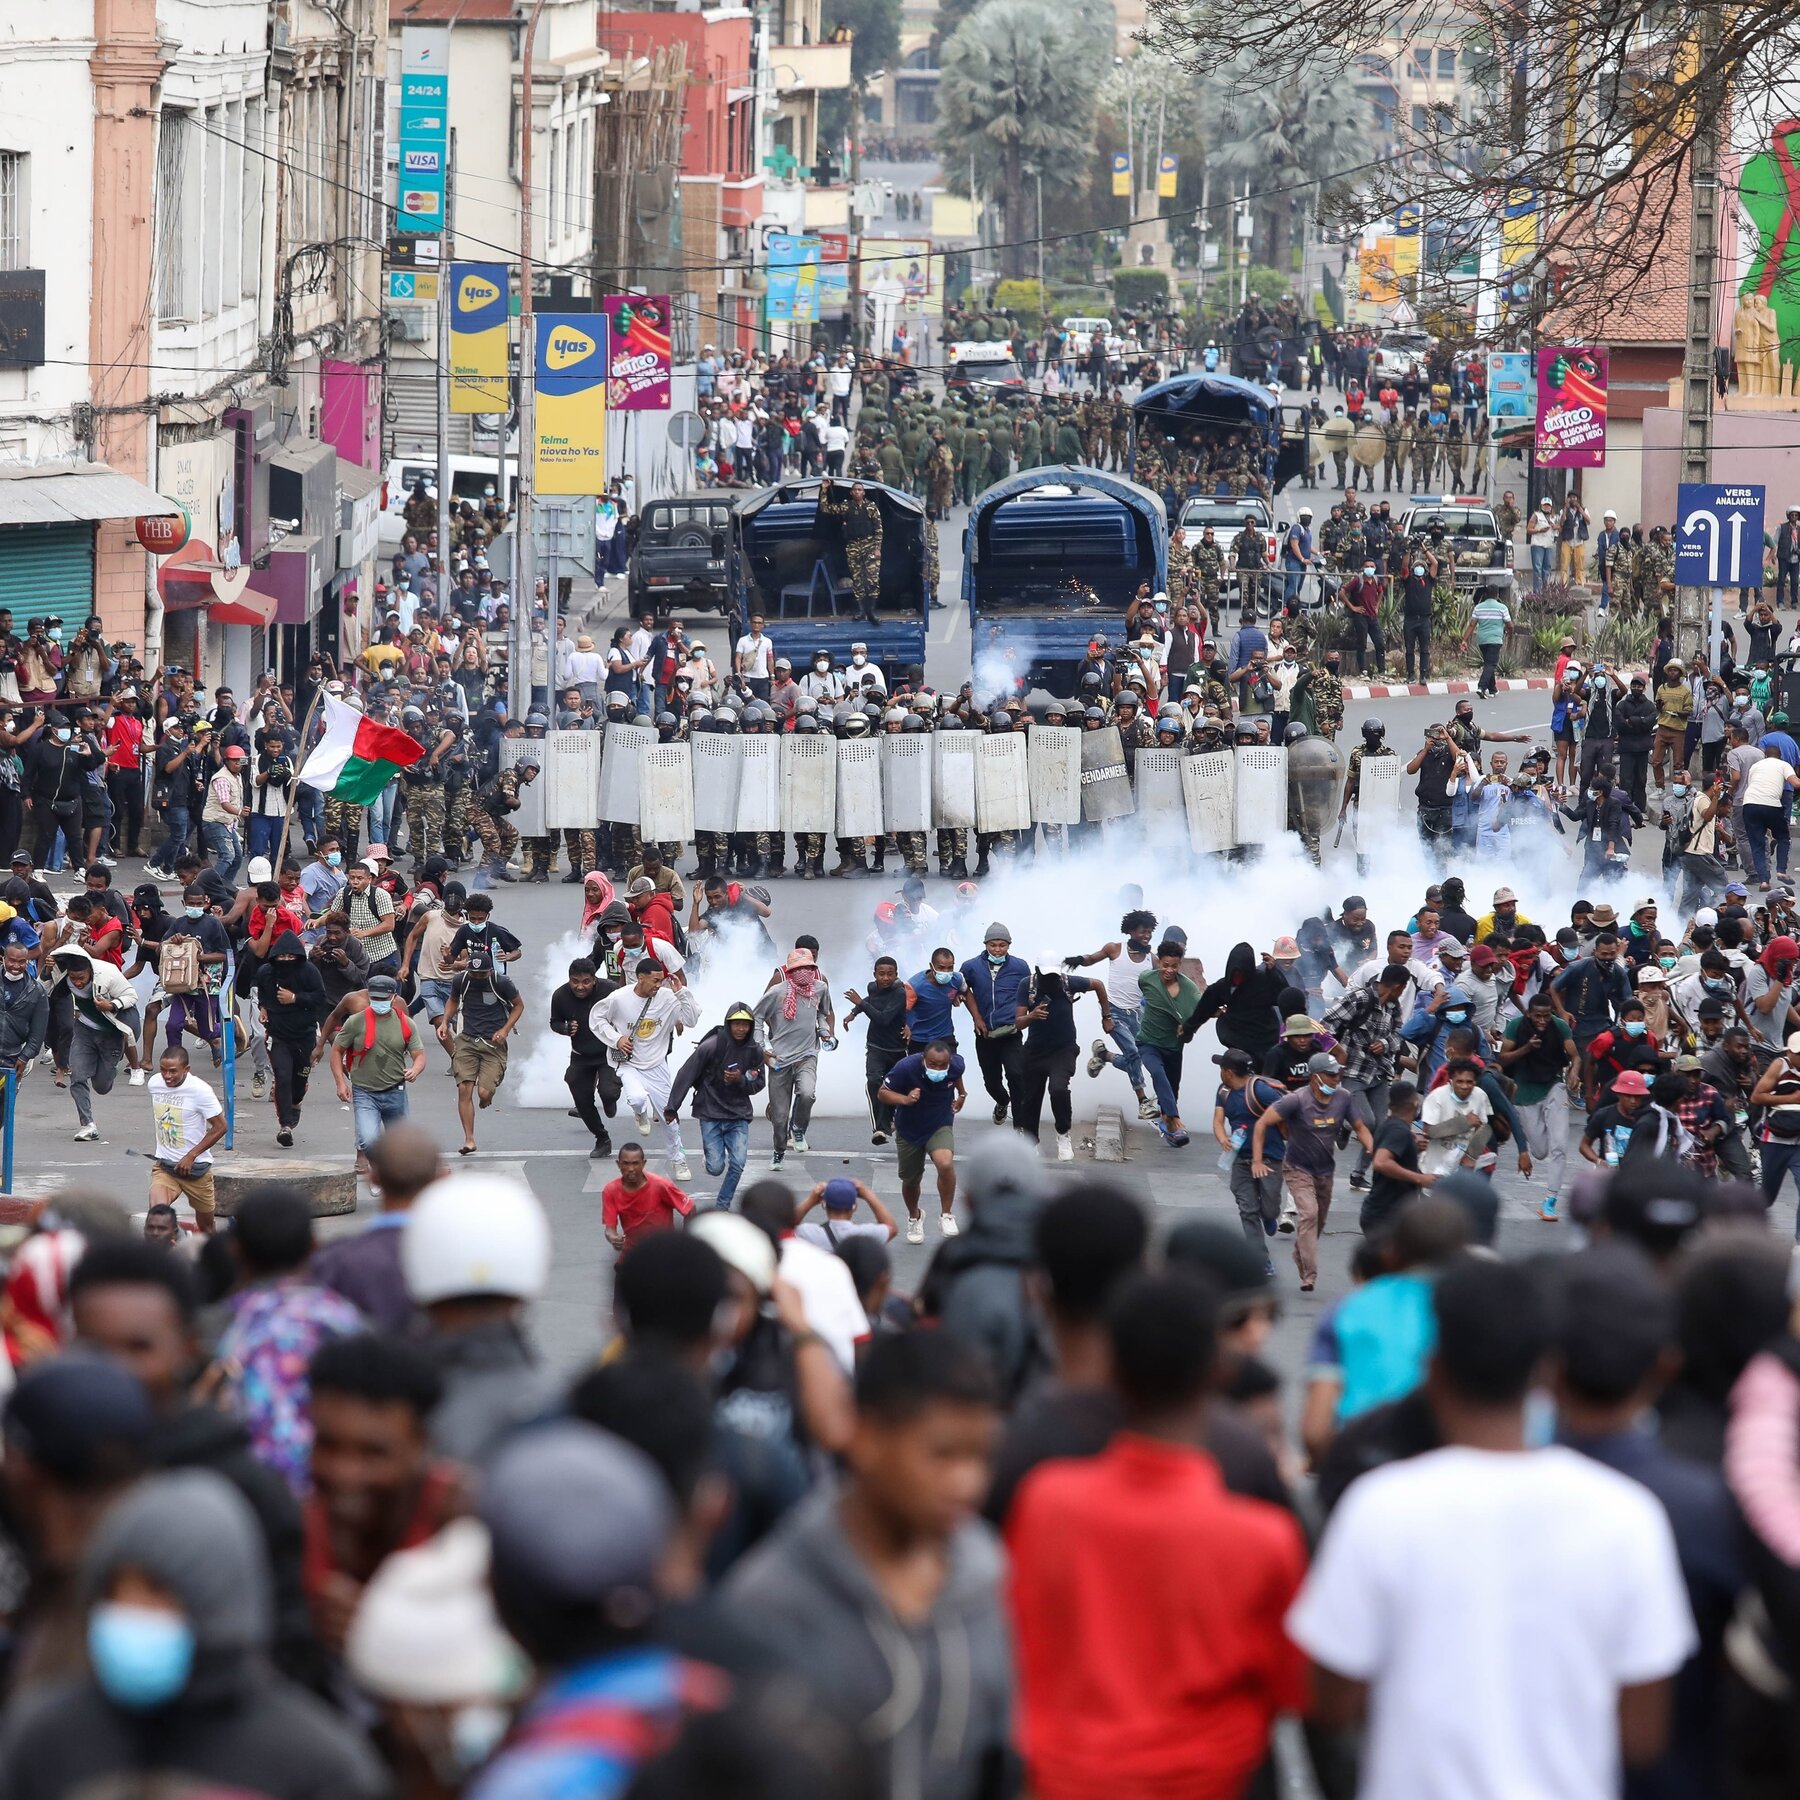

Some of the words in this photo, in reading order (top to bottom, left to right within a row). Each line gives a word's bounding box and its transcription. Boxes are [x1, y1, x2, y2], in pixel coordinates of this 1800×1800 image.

[407, 85, 441, 96] 24/24
[409, 154, 437, 166] VISA
[455, 367, 479, 375] Telma
[540, 435, 568, 444] Telma
[1563, 434, 1586, 447] SUPER
[1586, 428, 1604, 441] HERO
[540, 447, 567, 455] niova
[568, 447, 580, 455] ho
[582, 447, 599, 456] Yas
[1725, 488, 1752, 497] VERS
[1715, 496, 1760, 506] ANALAKELY
[143, 521, 172, 538] THB
[1081, 764, 1127, 785] GENDARMERIE
[1510, 817, 1537, 825] PRESSE
